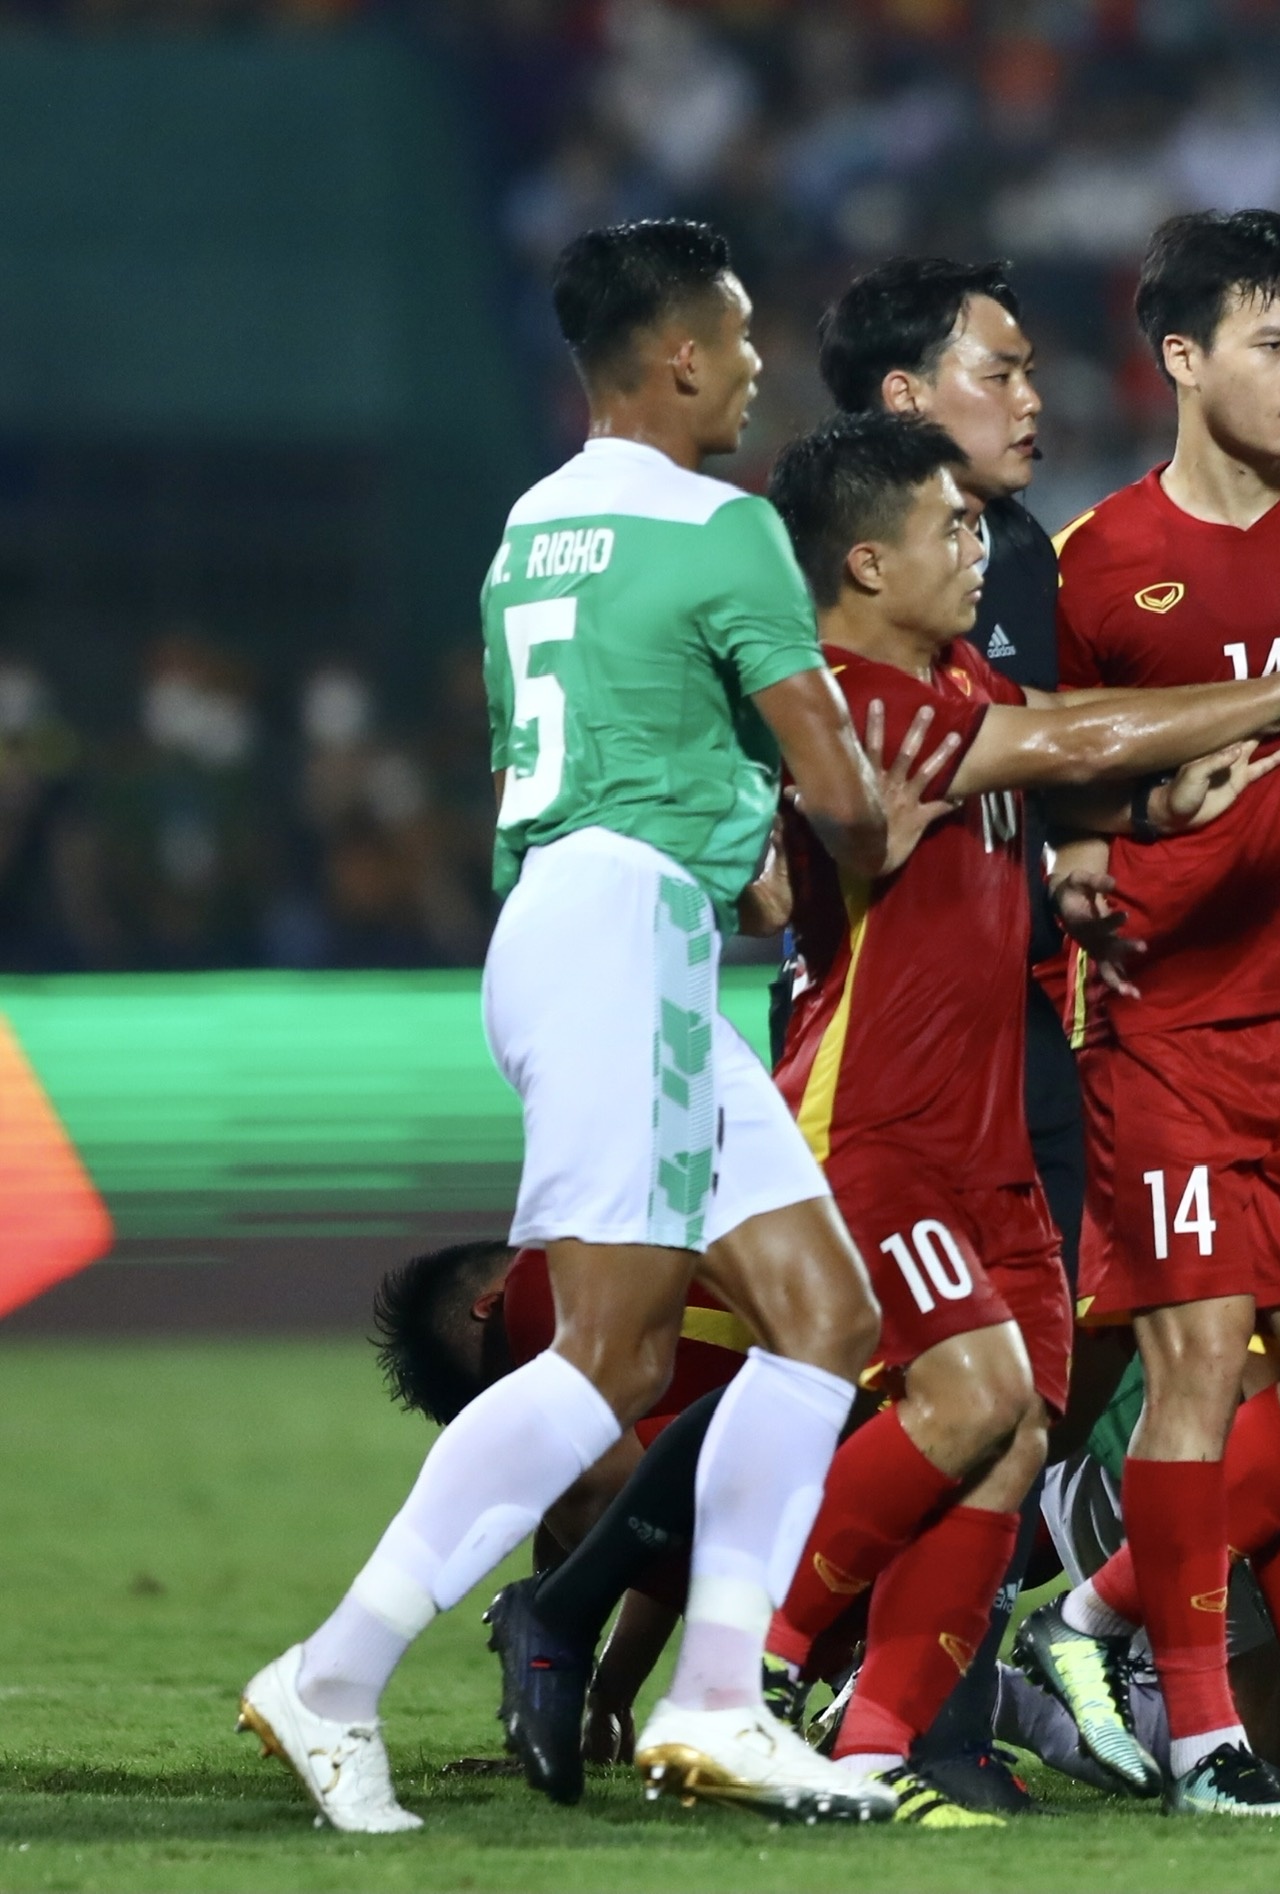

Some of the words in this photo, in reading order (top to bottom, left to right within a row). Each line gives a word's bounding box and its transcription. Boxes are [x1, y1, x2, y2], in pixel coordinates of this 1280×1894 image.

[526, 527, 615, 579] RIDHO
[987, 645, 1016, 659] adidas
[497, 597, 578, 829] 5
[1143, 1165, 1216, 1259] 14
[880, 1218, 973, 1314] 10
